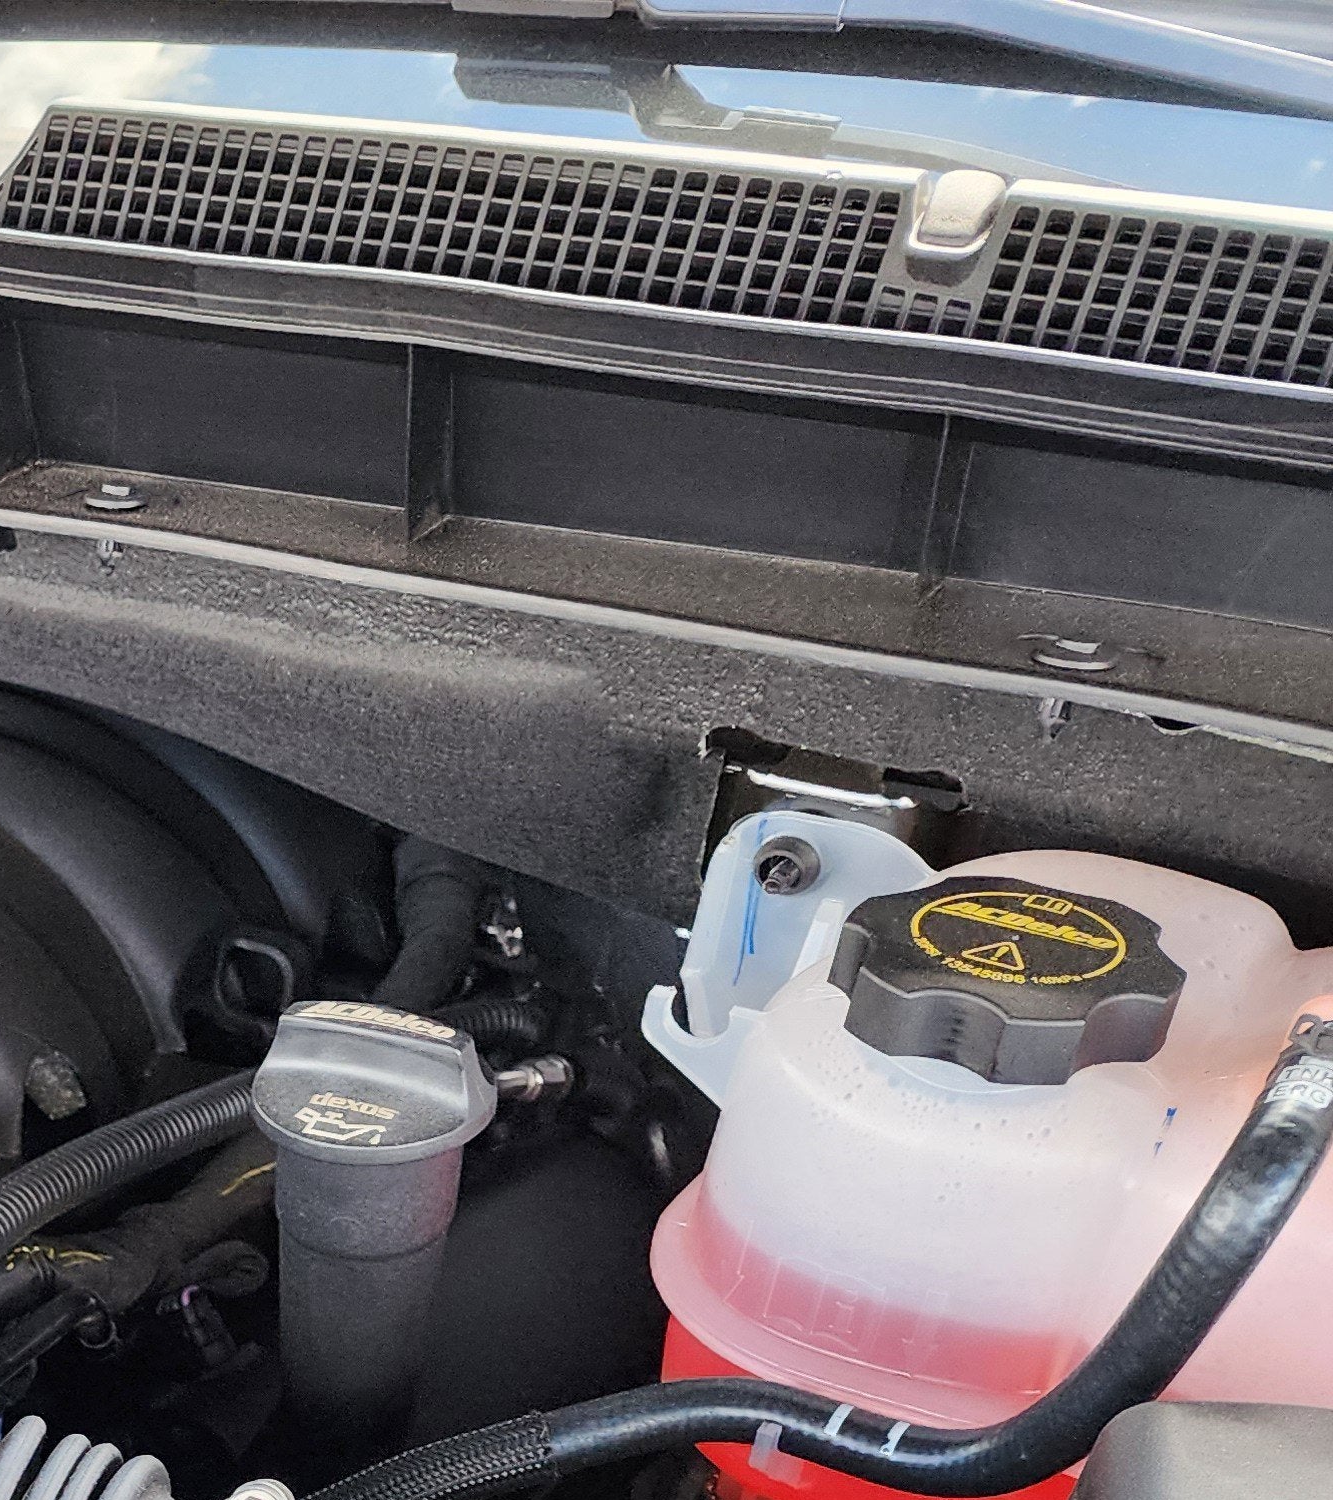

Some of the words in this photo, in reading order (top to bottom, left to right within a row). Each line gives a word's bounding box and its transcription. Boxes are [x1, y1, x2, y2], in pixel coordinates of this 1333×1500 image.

[940, 901, 1118, 949] ACDelco
[299, 1000, 456, 1039] ACDelco
[308, 1091, 400, 1120] dexos
